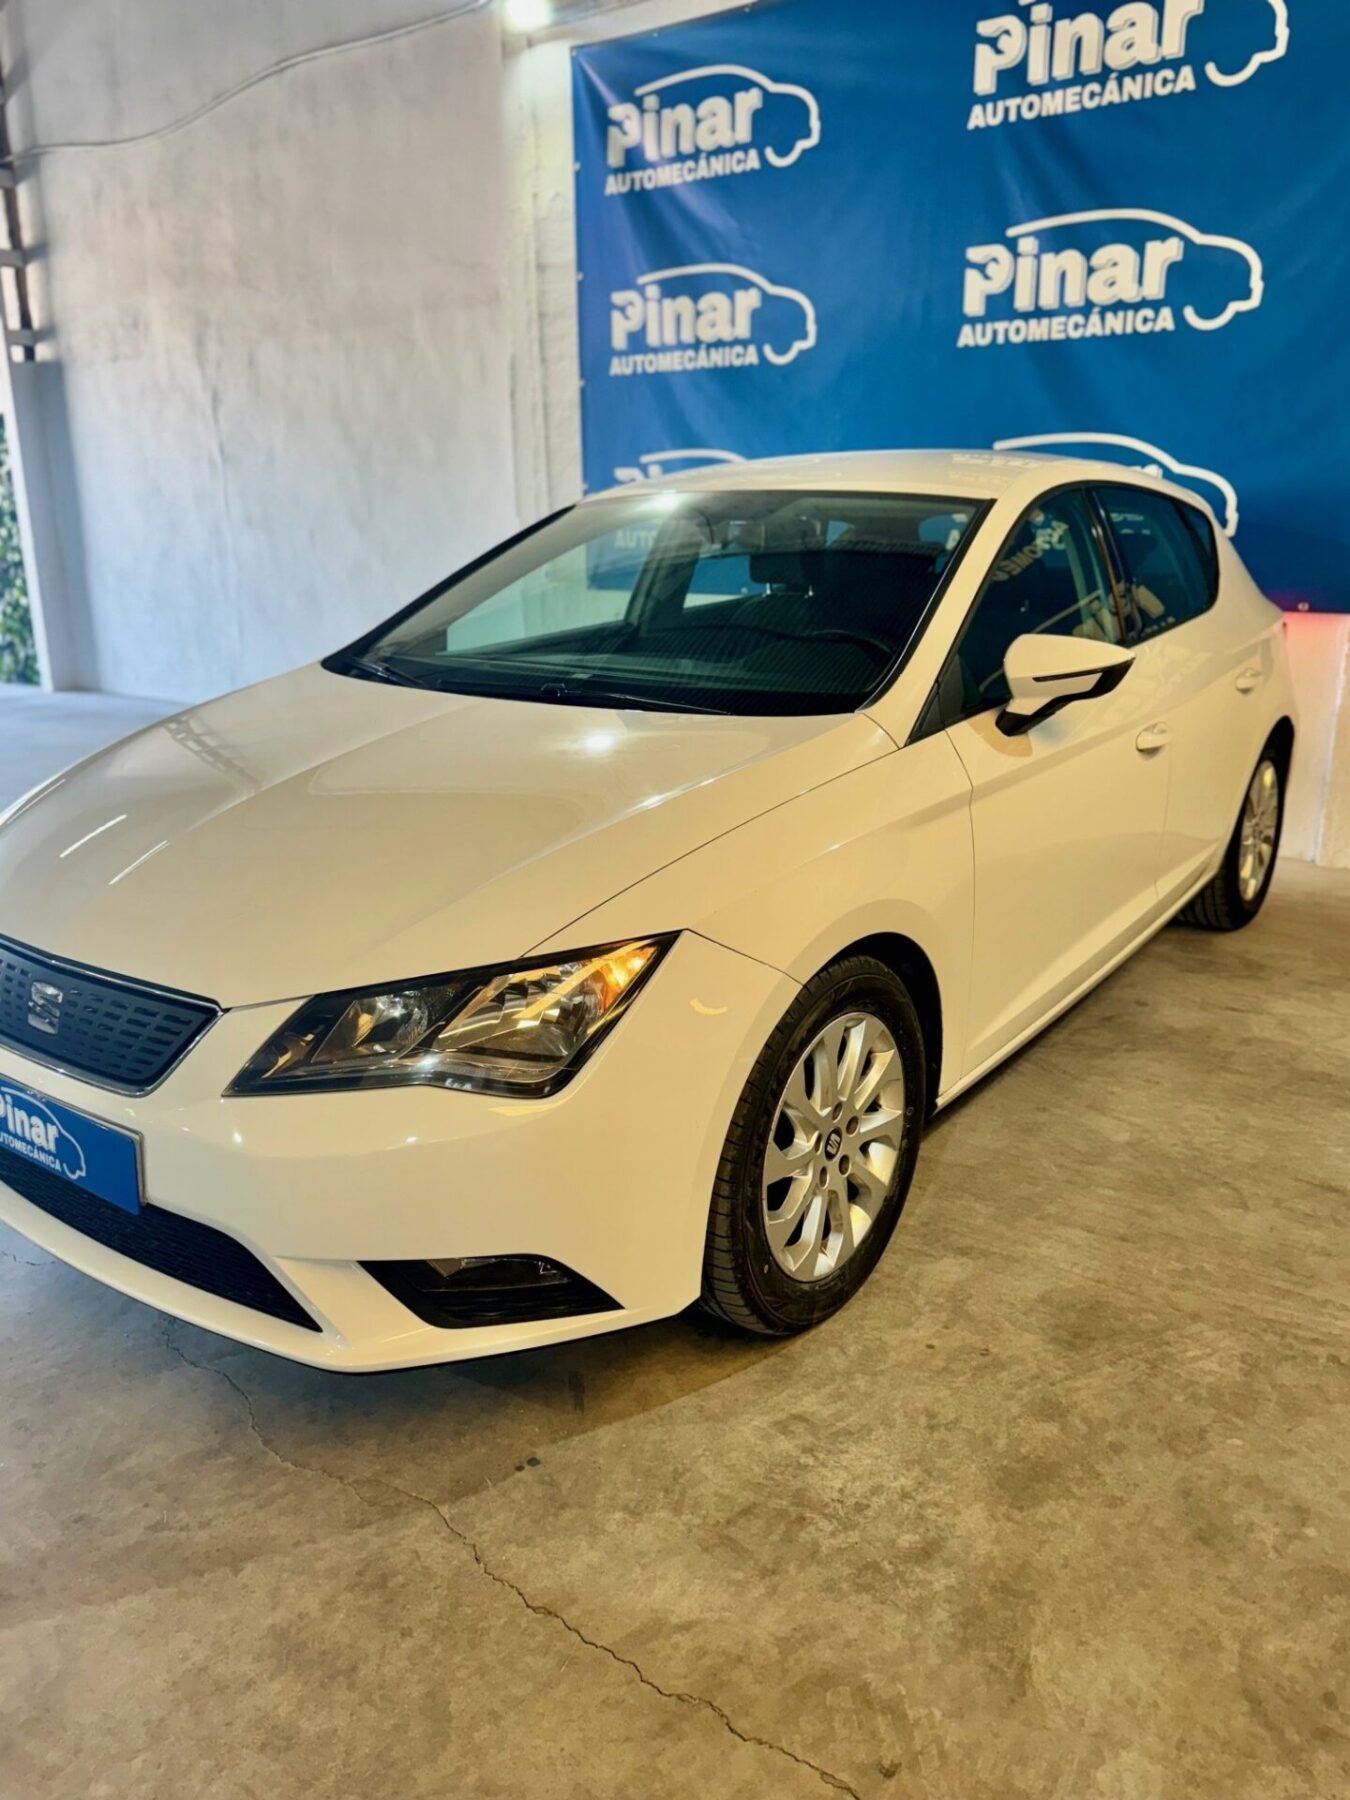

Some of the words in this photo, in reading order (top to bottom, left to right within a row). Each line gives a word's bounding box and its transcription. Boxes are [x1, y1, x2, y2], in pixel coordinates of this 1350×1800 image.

[975, 0, 1203, 95] Pinar
[608, 88, 761, 166] Pinar
[968, 66, 1195, 129] AUTOMECÁNICA
[606, 149, 759, 194] AUTOMECÁNICA
[964, 237, 1184, 316] Pinar
[611, 286, 761, 349] Pinar
[957, 307, 1174, 346] AUTOMECÁNICA
[610, 345, 758, 375] AUTOMECÁNICA
